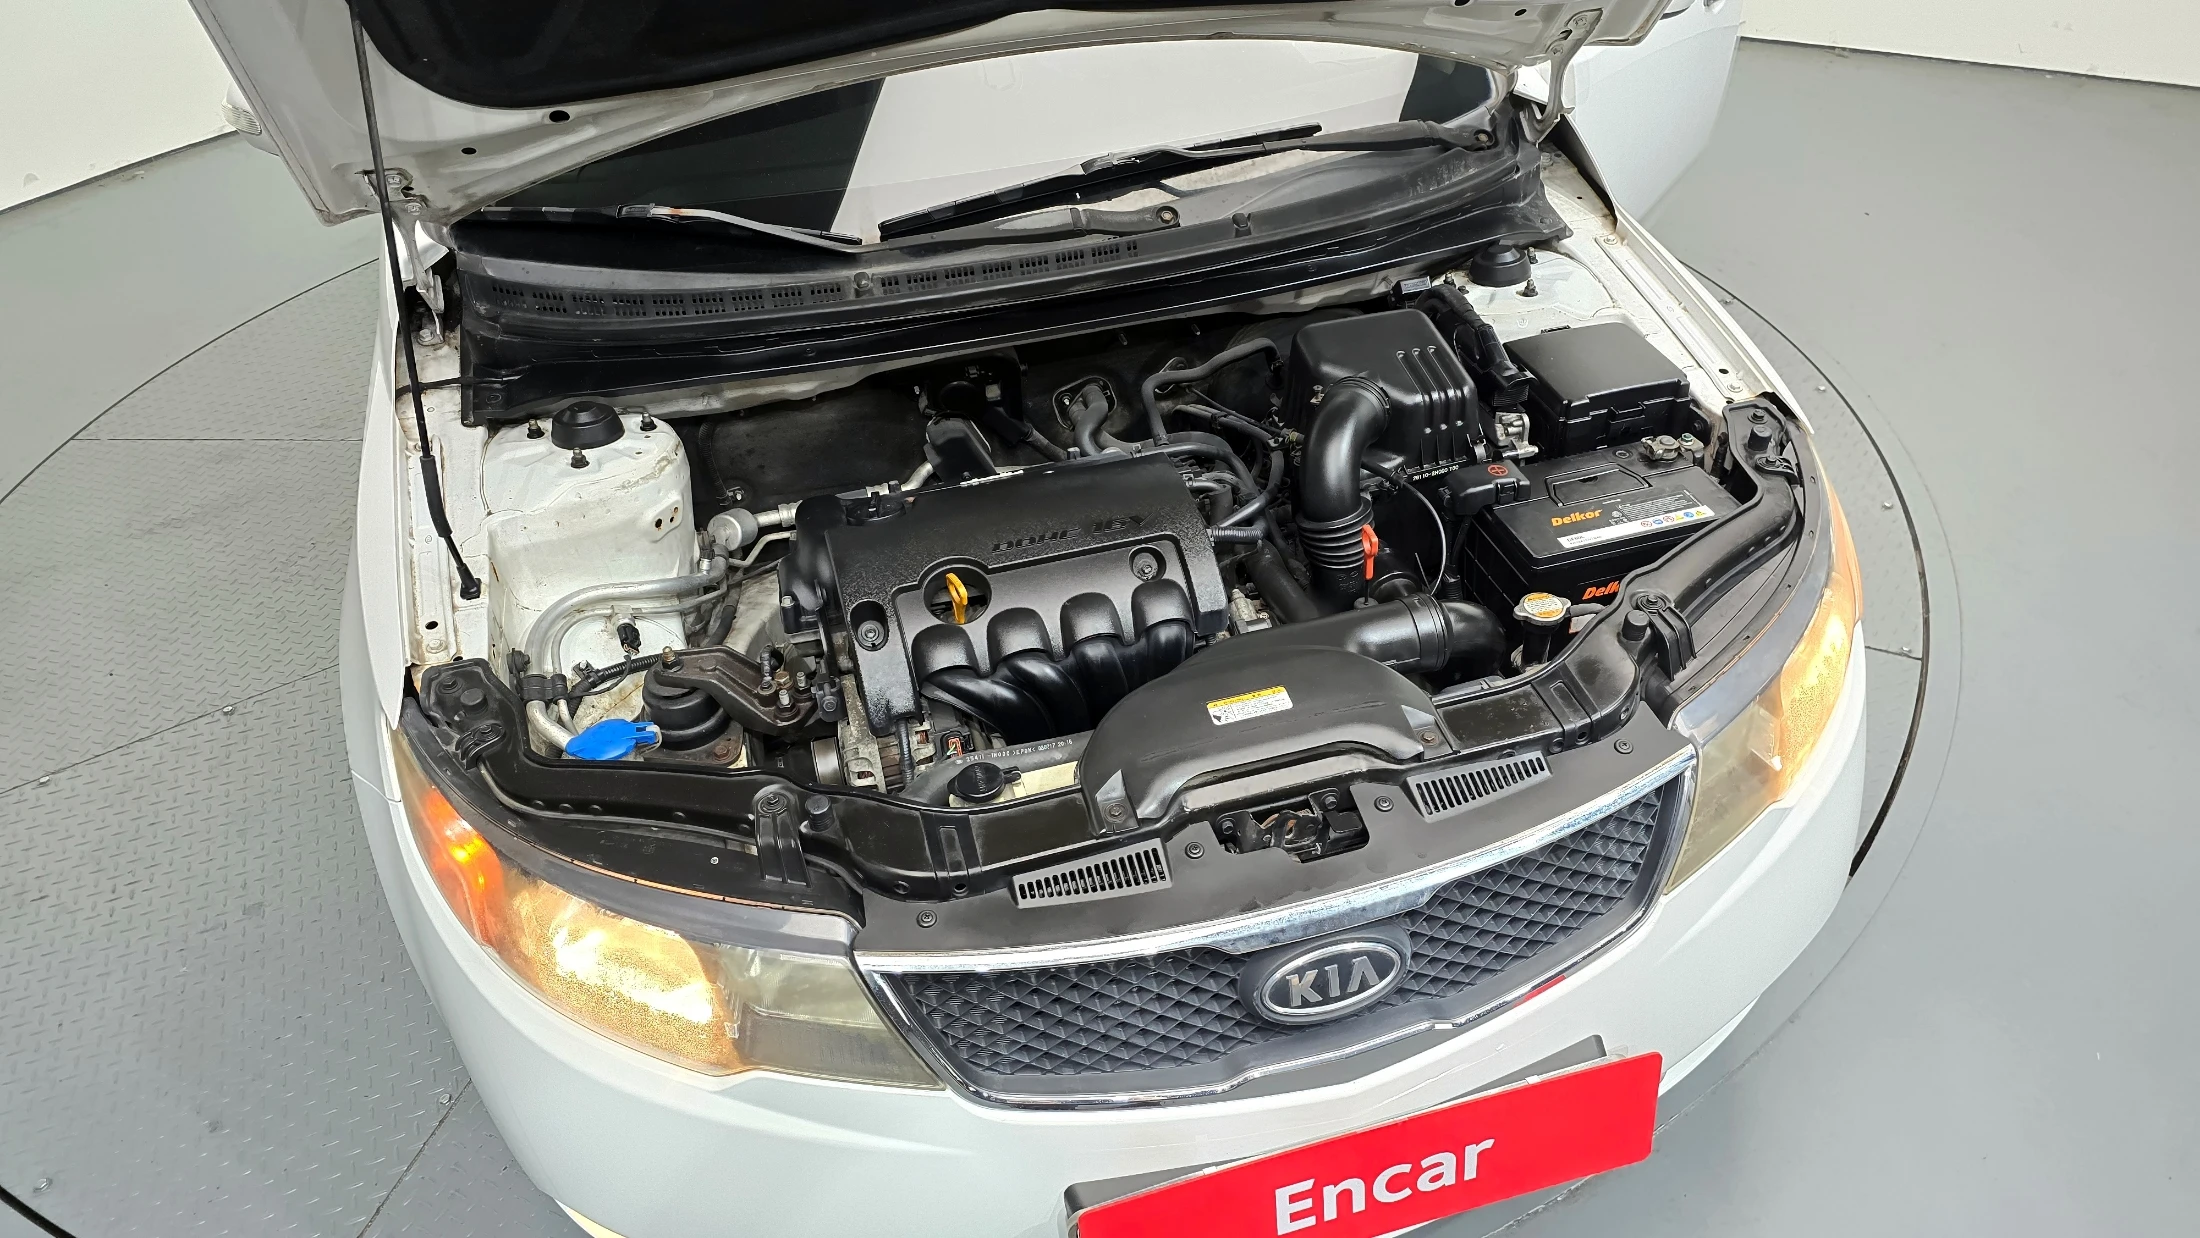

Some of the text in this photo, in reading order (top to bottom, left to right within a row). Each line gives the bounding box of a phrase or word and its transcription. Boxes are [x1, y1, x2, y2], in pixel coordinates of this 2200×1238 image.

[992, 512, 1154, 554] DOHC 16V
[1551, 508, 1603, 527] Delkor
[1582, 580, 1620, 600] Delk
[1286, 955, 1380, 1008] KIA
[1275, 1138, 1496, 1236] Encar
